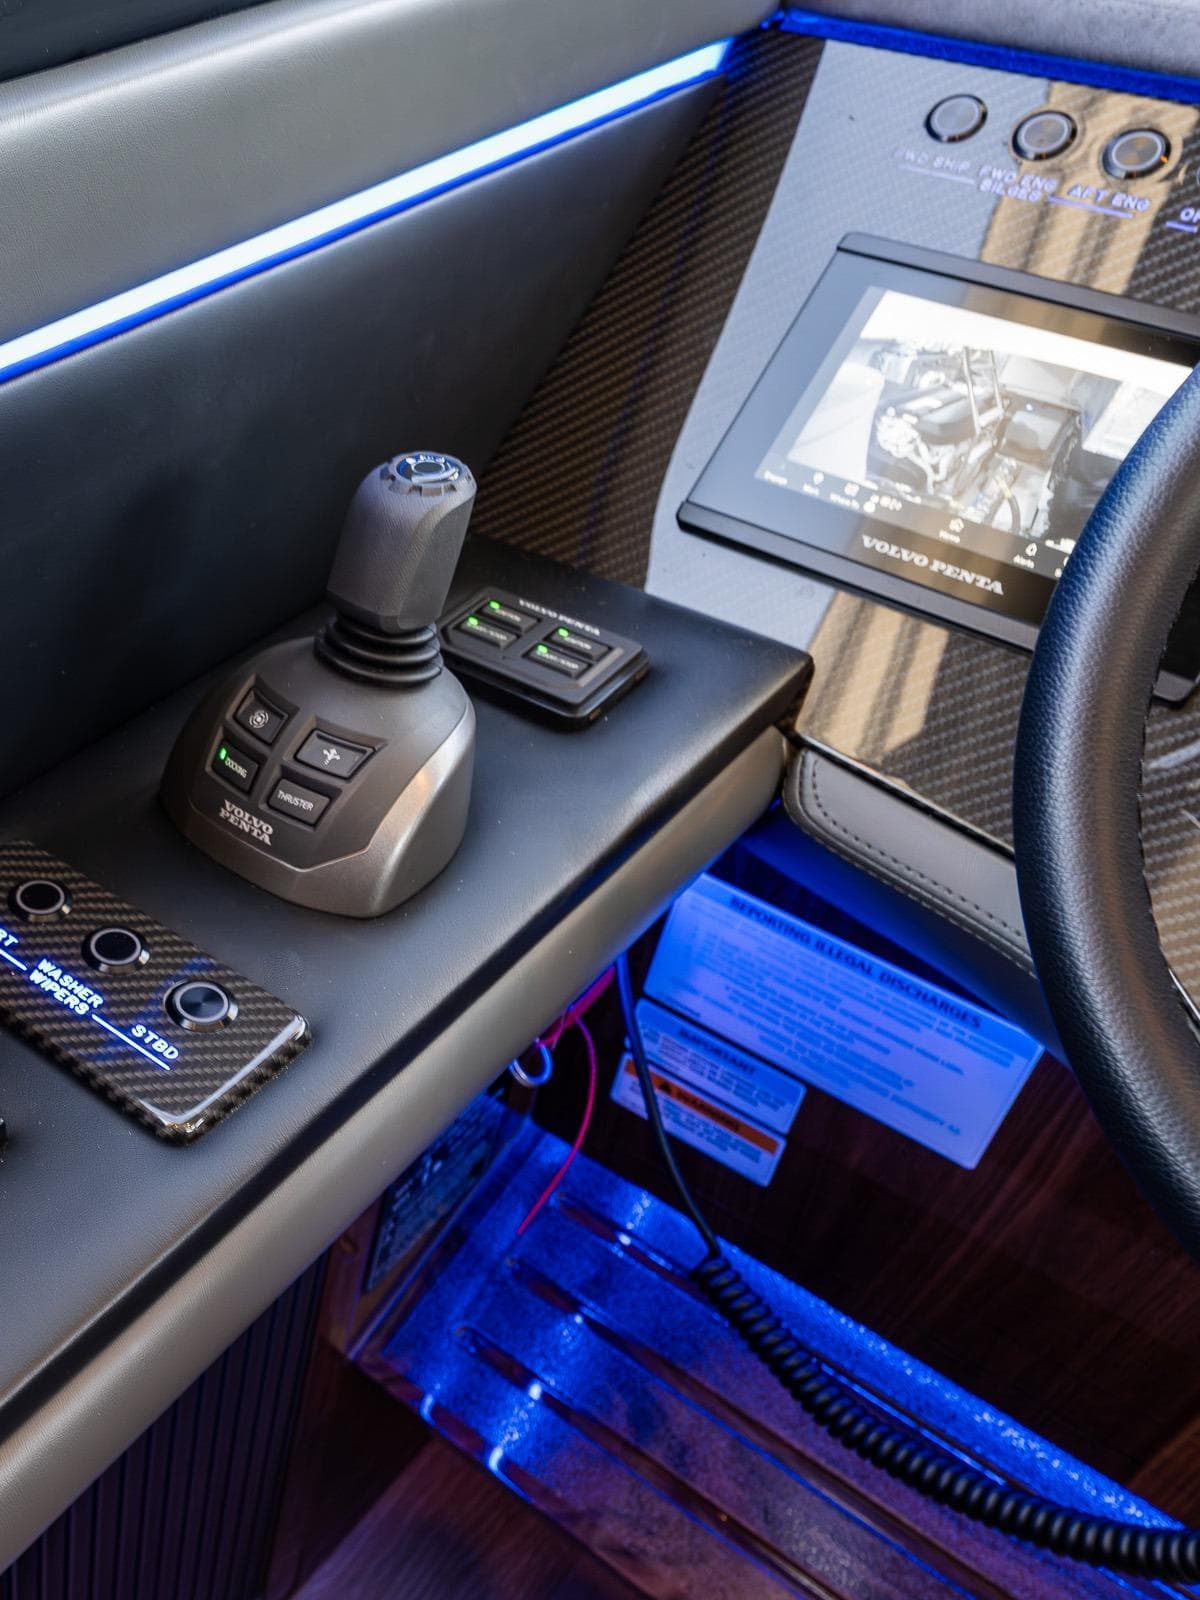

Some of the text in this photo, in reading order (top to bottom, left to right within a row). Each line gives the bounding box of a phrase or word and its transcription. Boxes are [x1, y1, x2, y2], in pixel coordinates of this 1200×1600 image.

[1067, 184, 1151, 212] AFT ENG
[862, 534, 930, 569] VOLVO
[929, 558, 1005, 597] PENTA
[224, 800, 274, 836] VOLVO
[277, 790, 314, 812] THRUSTER
[219, 808, 272, 846] PENTA
[28, 969, 90, 1016] WIPERS
[37, 957, 105, 1010] WASHER
[814, 938, 875, 977] ILLEGAL
[879, 970, 982, 1030] DISCHARGES
[130, 1023, 180, 1061] STBD
